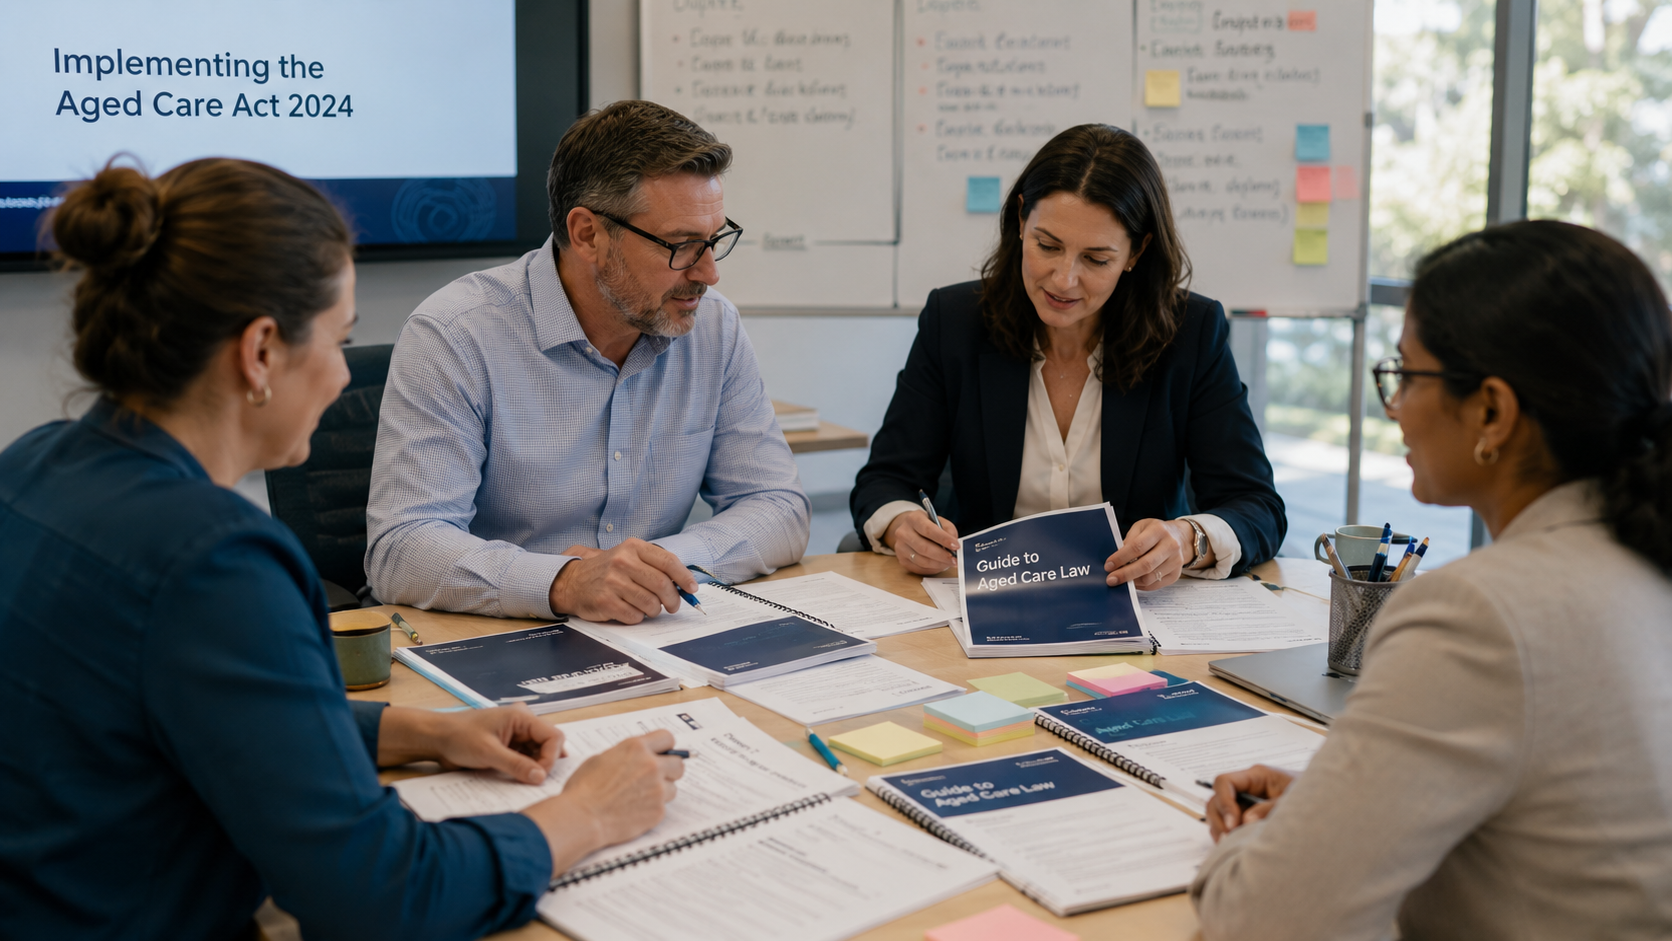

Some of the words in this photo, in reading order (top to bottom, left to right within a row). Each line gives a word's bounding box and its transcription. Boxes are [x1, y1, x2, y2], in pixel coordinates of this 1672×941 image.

[54, 48, 269, 84] Implementing
[278, 54, 324, 79] the
[55, 90, 143, 123] Aged
[153, 91, 223, 117] Care
[232, 93, 280, 117] Act
[288, 94, 354, 117] 2024
[976, 554, 1020, 572] Guide
[1023, 552, 1039, 564] to
[977, 572, 1017, 591] Aged
[1021, 570, 1057, 584] Care
[1060, 565, 1091, 579] Law
[920, 784, 974, 799] Guide
[973, 781, 994, 790] to
[934, 793, 980, 808] Aged
[979, 786, 1021, 800] Care
[1020, 781, 1055, 794] Law
